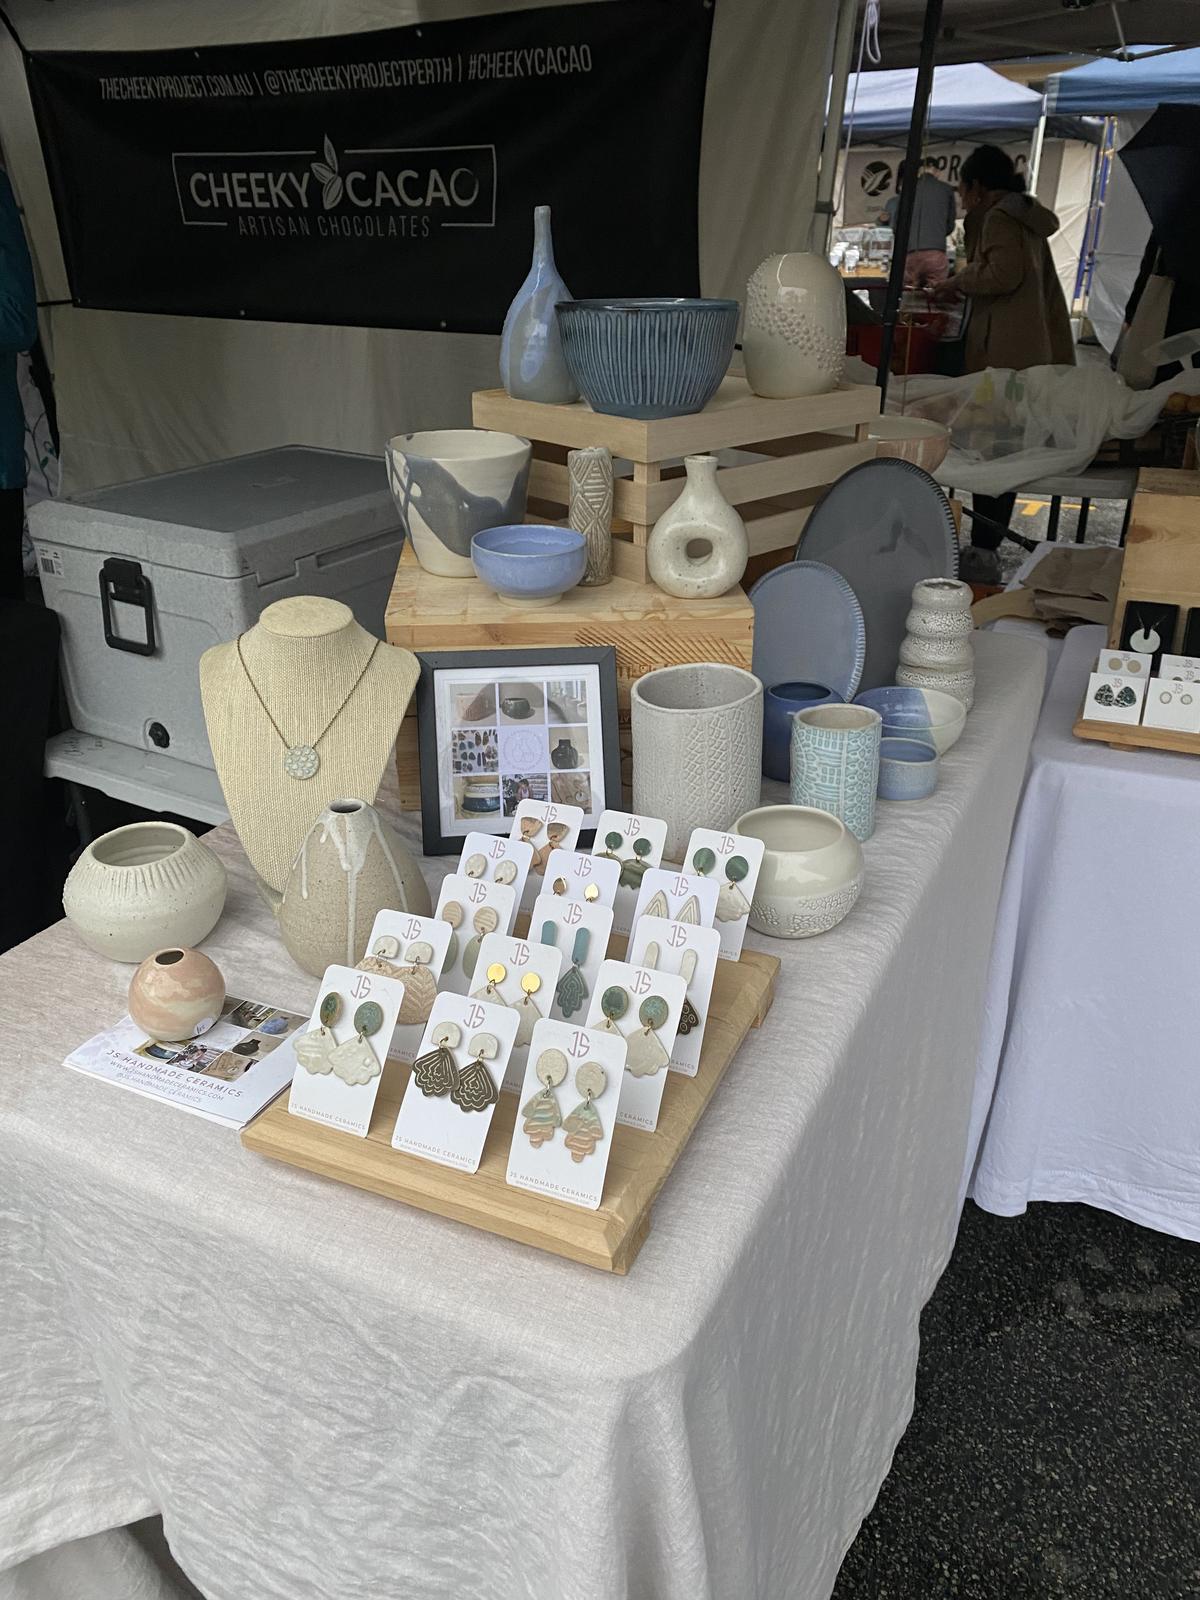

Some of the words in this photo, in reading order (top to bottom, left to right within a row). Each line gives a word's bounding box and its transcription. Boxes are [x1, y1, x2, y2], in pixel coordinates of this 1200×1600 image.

[99, 72, 254, 100] THECHEEKYPROJECT.COM.AU
[264, 57, 452, 95] @THECHEEKYPROJECTPERTH
[468, 44, 592, 80] #CHEEKYCACAO
[189, 172, 310, 208] CHEEKY
[345, 167, 479, 208] CACAO
[238, 215, 310, 237] ARTISAN
[317, 215, 430, 238] CHOCOLATES
[540, 805, 558, 823] JS
[623, 818, 640, 836] JS
[488, 840, 506, 859] JS
[716, 835, 735, 854] JS
[574, 857, 592, 877] JS
[468, 882, 487, 903] JS
[670, 877, 689, 897] JS
[563, 903, 583, 924] JS
[401, 918, 422, 941] JS
[666, 924, 687, 948] JS
[509, 943, 530, 966] JS
[350, 975, 371, 999] JS
[630, 970, 652, 994] JS
[463, 1003, 486, 1029] JS
[567, 1031, 591, 1057] JS
[106, 1049, 121, 1059] JS
[122, 1057, 184, 1080] HANDMADE
[186, 1075, 244, 1098] CERAMICS
[300, 1105, 333, 1120] HANDMADE
[334, 1116, 366, 1130] CERAMICS
[404, 1138, 440, 1154] HANDMADE
[442, 1150, 476, 1166] CERAMICS
[519, 1175, 560, 1191] HANDMADE
[561, 1186, 598, 1202] CERAMICS
